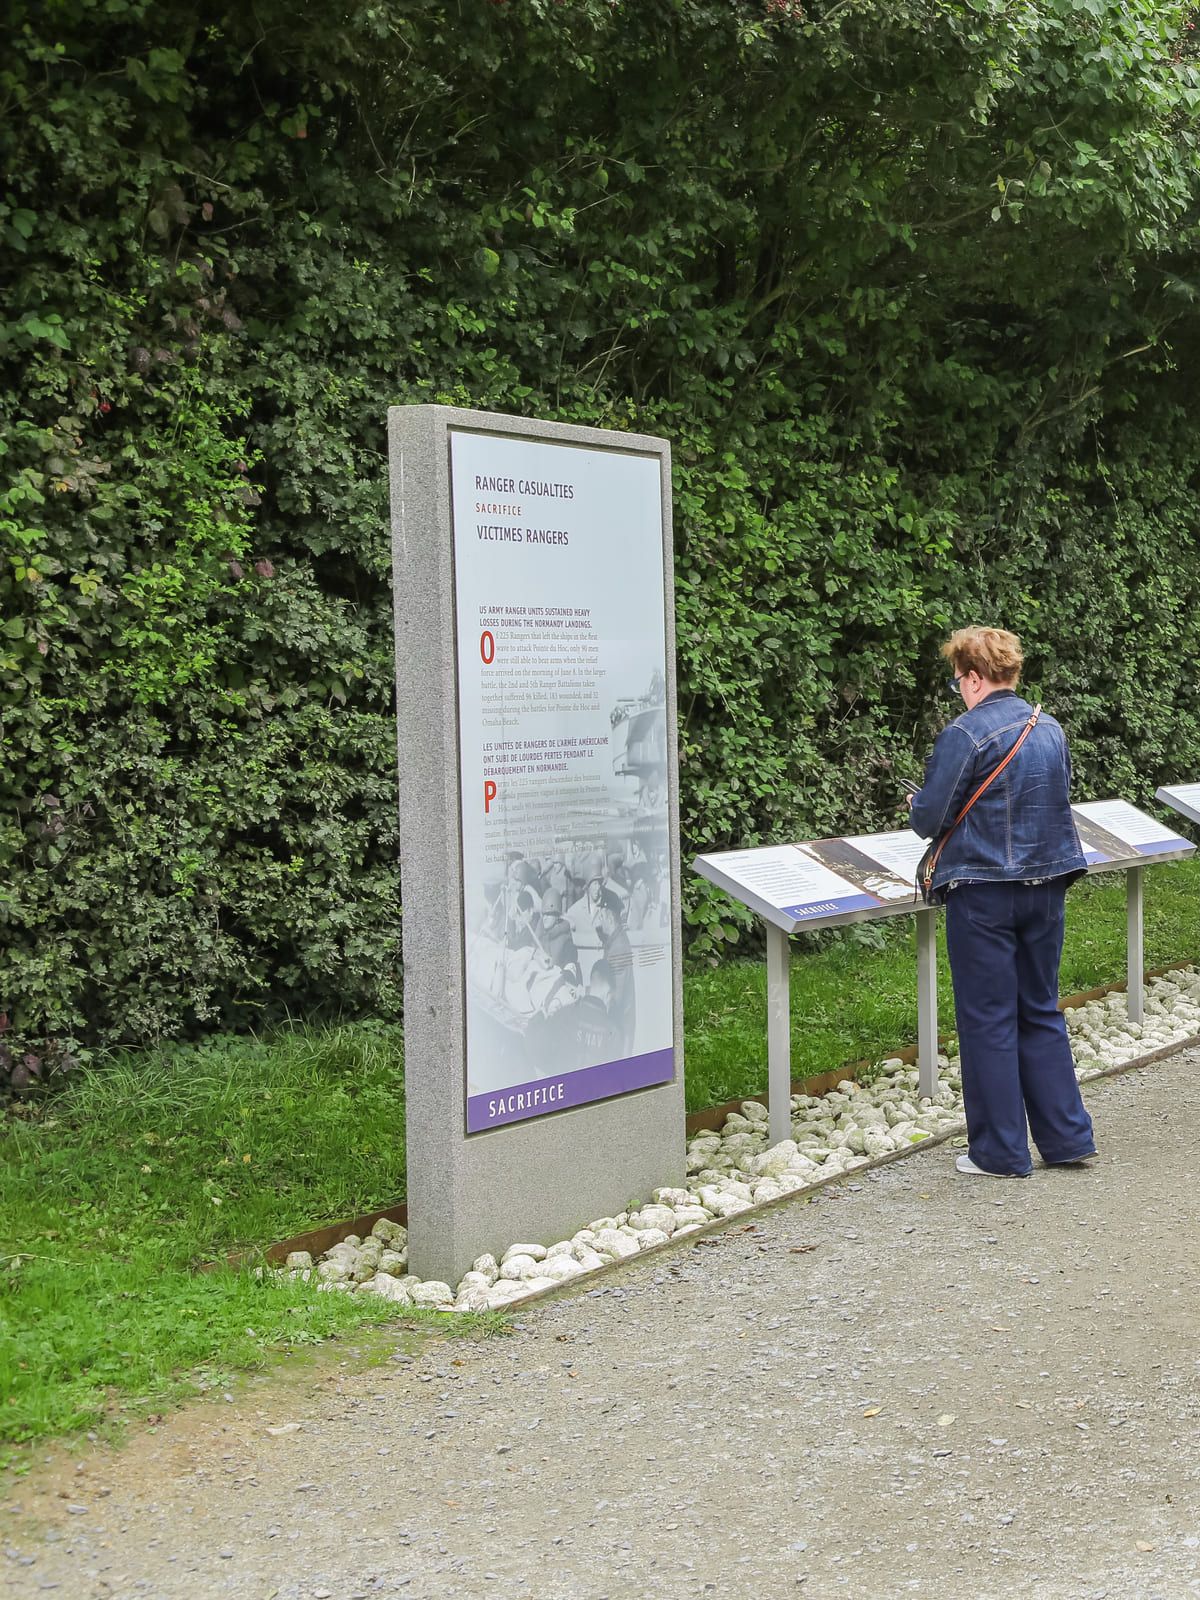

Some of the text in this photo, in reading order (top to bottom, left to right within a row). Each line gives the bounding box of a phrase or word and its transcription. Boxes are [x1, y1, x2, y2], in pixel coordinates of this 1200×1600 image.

[476, 476, 574, 499] RANGER CASUALTIES
[476, 502, 522, 516] SACRIFICE
[477, 525, 569, 546] VICTIMES RANGERS
[480, 606, 590, 616] US ARMY RANGER UNITS SUSTAINED HEAVY
[480, 618, 592, 629] LOSSES DURING THE NORMANDY LANDINGS.
[515, 741, 522, 749] DE
[524, 740, 547, 749] RANGERS
[483, 755, 494, 763] ONT
[496, 755, 509, 763] SUBI
[520, 752, 542, 761] LOURDES
[544, 751, 562, 760] PERTES
[564, 750, 586, 759] PENDANT
[489, 1084, 564, 1118] SACRIFICE
